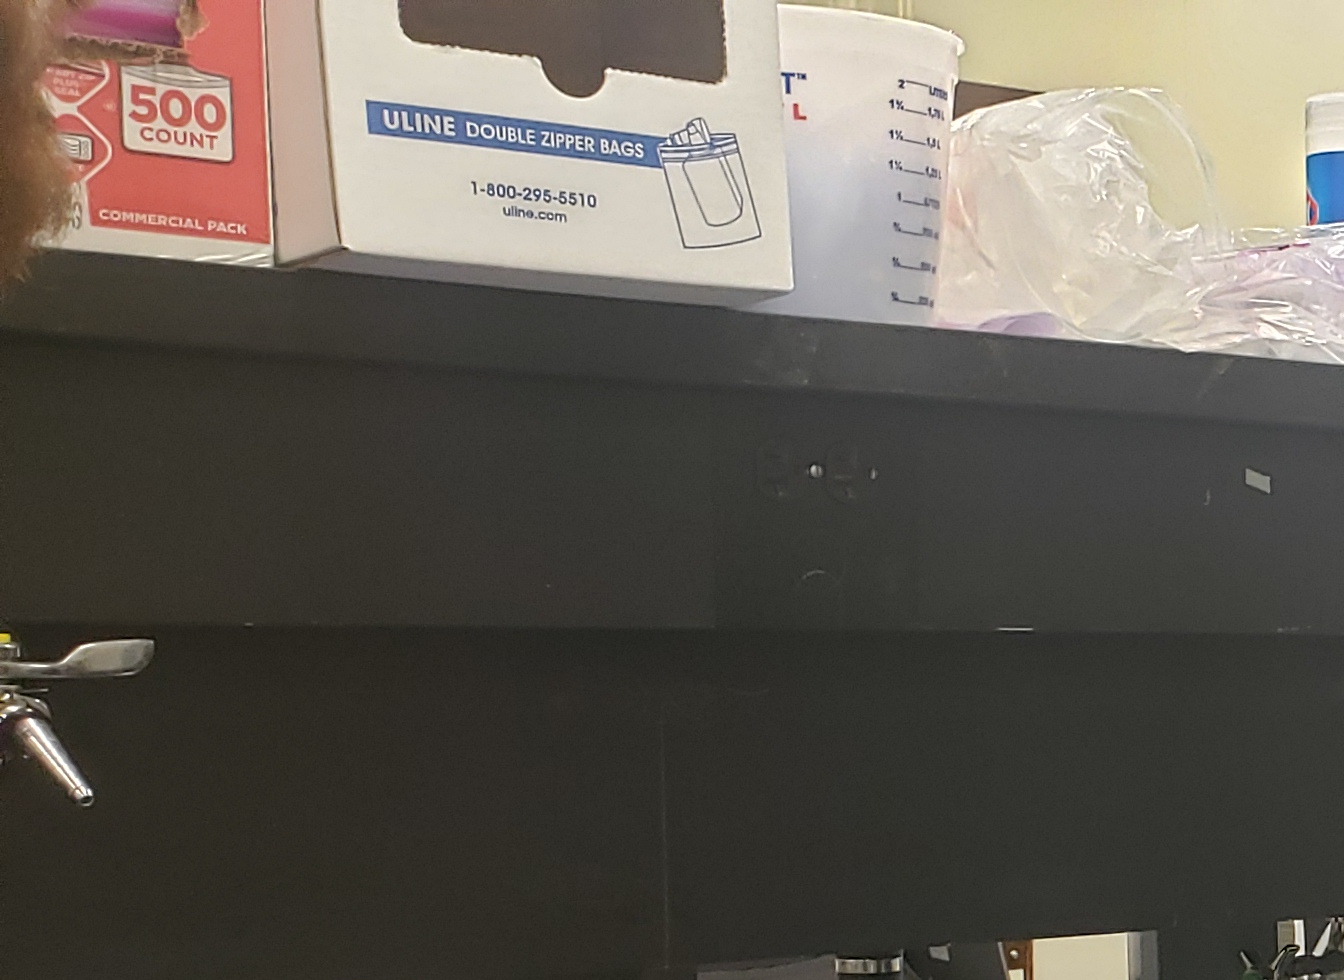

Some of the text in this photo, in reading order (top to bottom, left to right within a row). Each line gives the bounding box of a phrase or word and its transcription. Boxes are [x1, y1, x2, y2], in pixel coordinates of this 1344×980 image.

[128, 84, 227, 133] 500
[140, 127, 219, 150] COUNT
[382, 108, 645, 158] ULINE DOUBLE ZIPPER BAGS
[470, 180, 598, 209] 1-800-295-5510
[98, 209, 247, 236] COMMERCIAL PACK
[502, 206, 568, 224] uline.com
